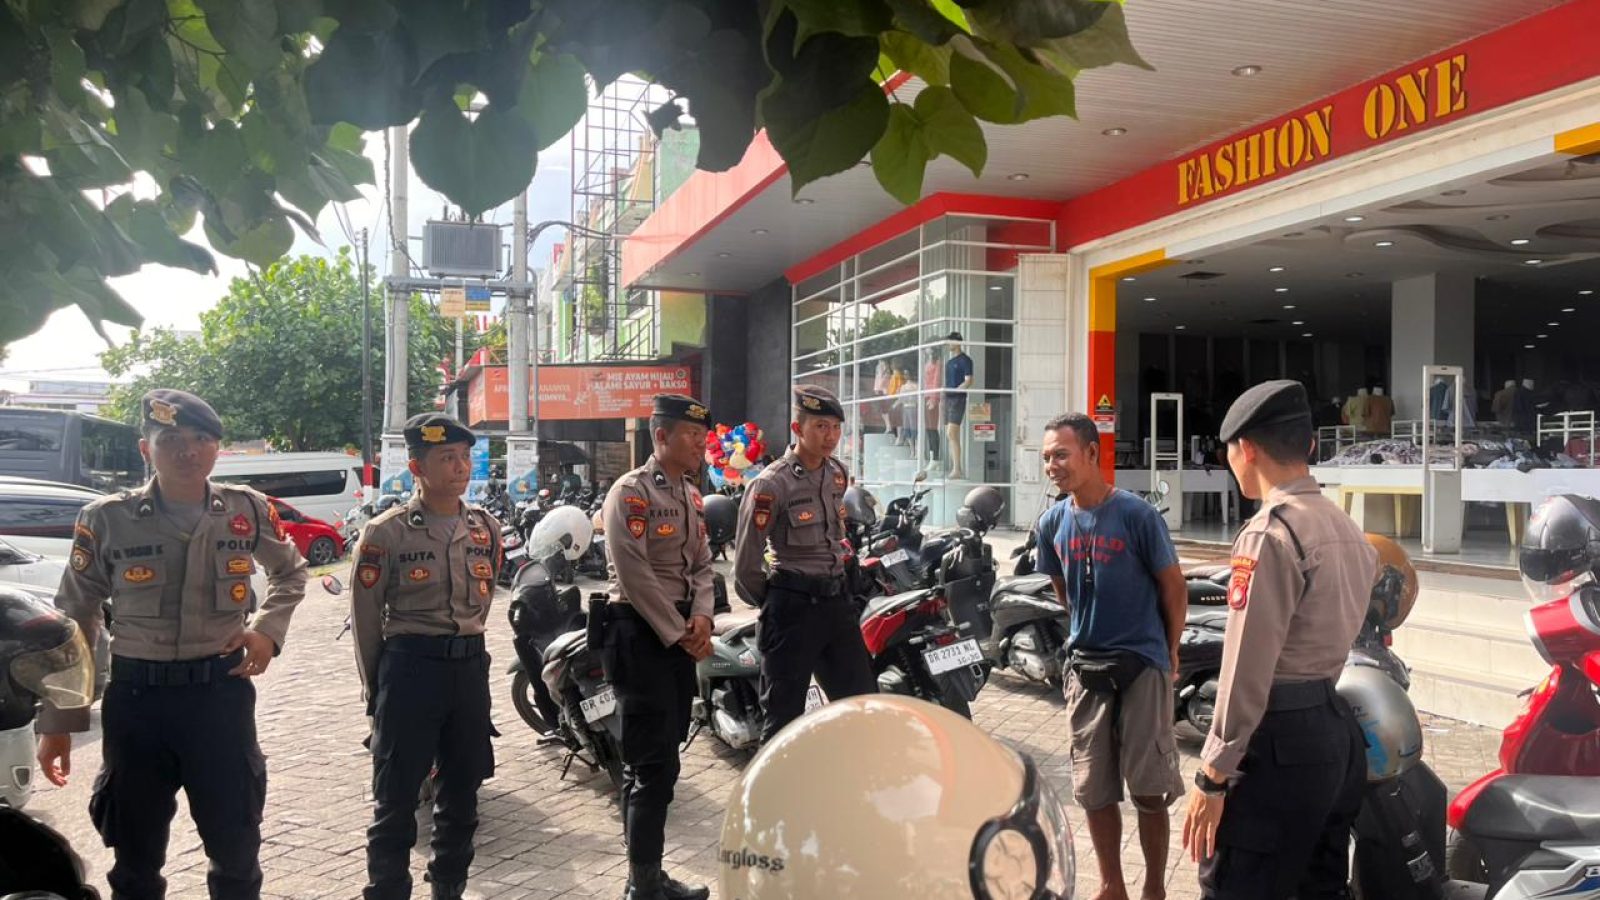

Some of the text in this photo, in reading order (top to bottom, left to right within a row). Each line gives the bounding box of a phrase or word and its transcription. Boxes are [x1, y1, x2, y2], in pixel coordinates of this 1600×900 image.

[1178, 54, 1467, 205] FASHION ONE
[624, 371, 648, 380] AYAM
[624, 381, 651, 389] SAYUR
[660, 380, 687, 389] BAKSO
[400, 551, 436, 563] SUTA
[928, 652, 941, 664] DR
[582, 699, 597, 711] DR
